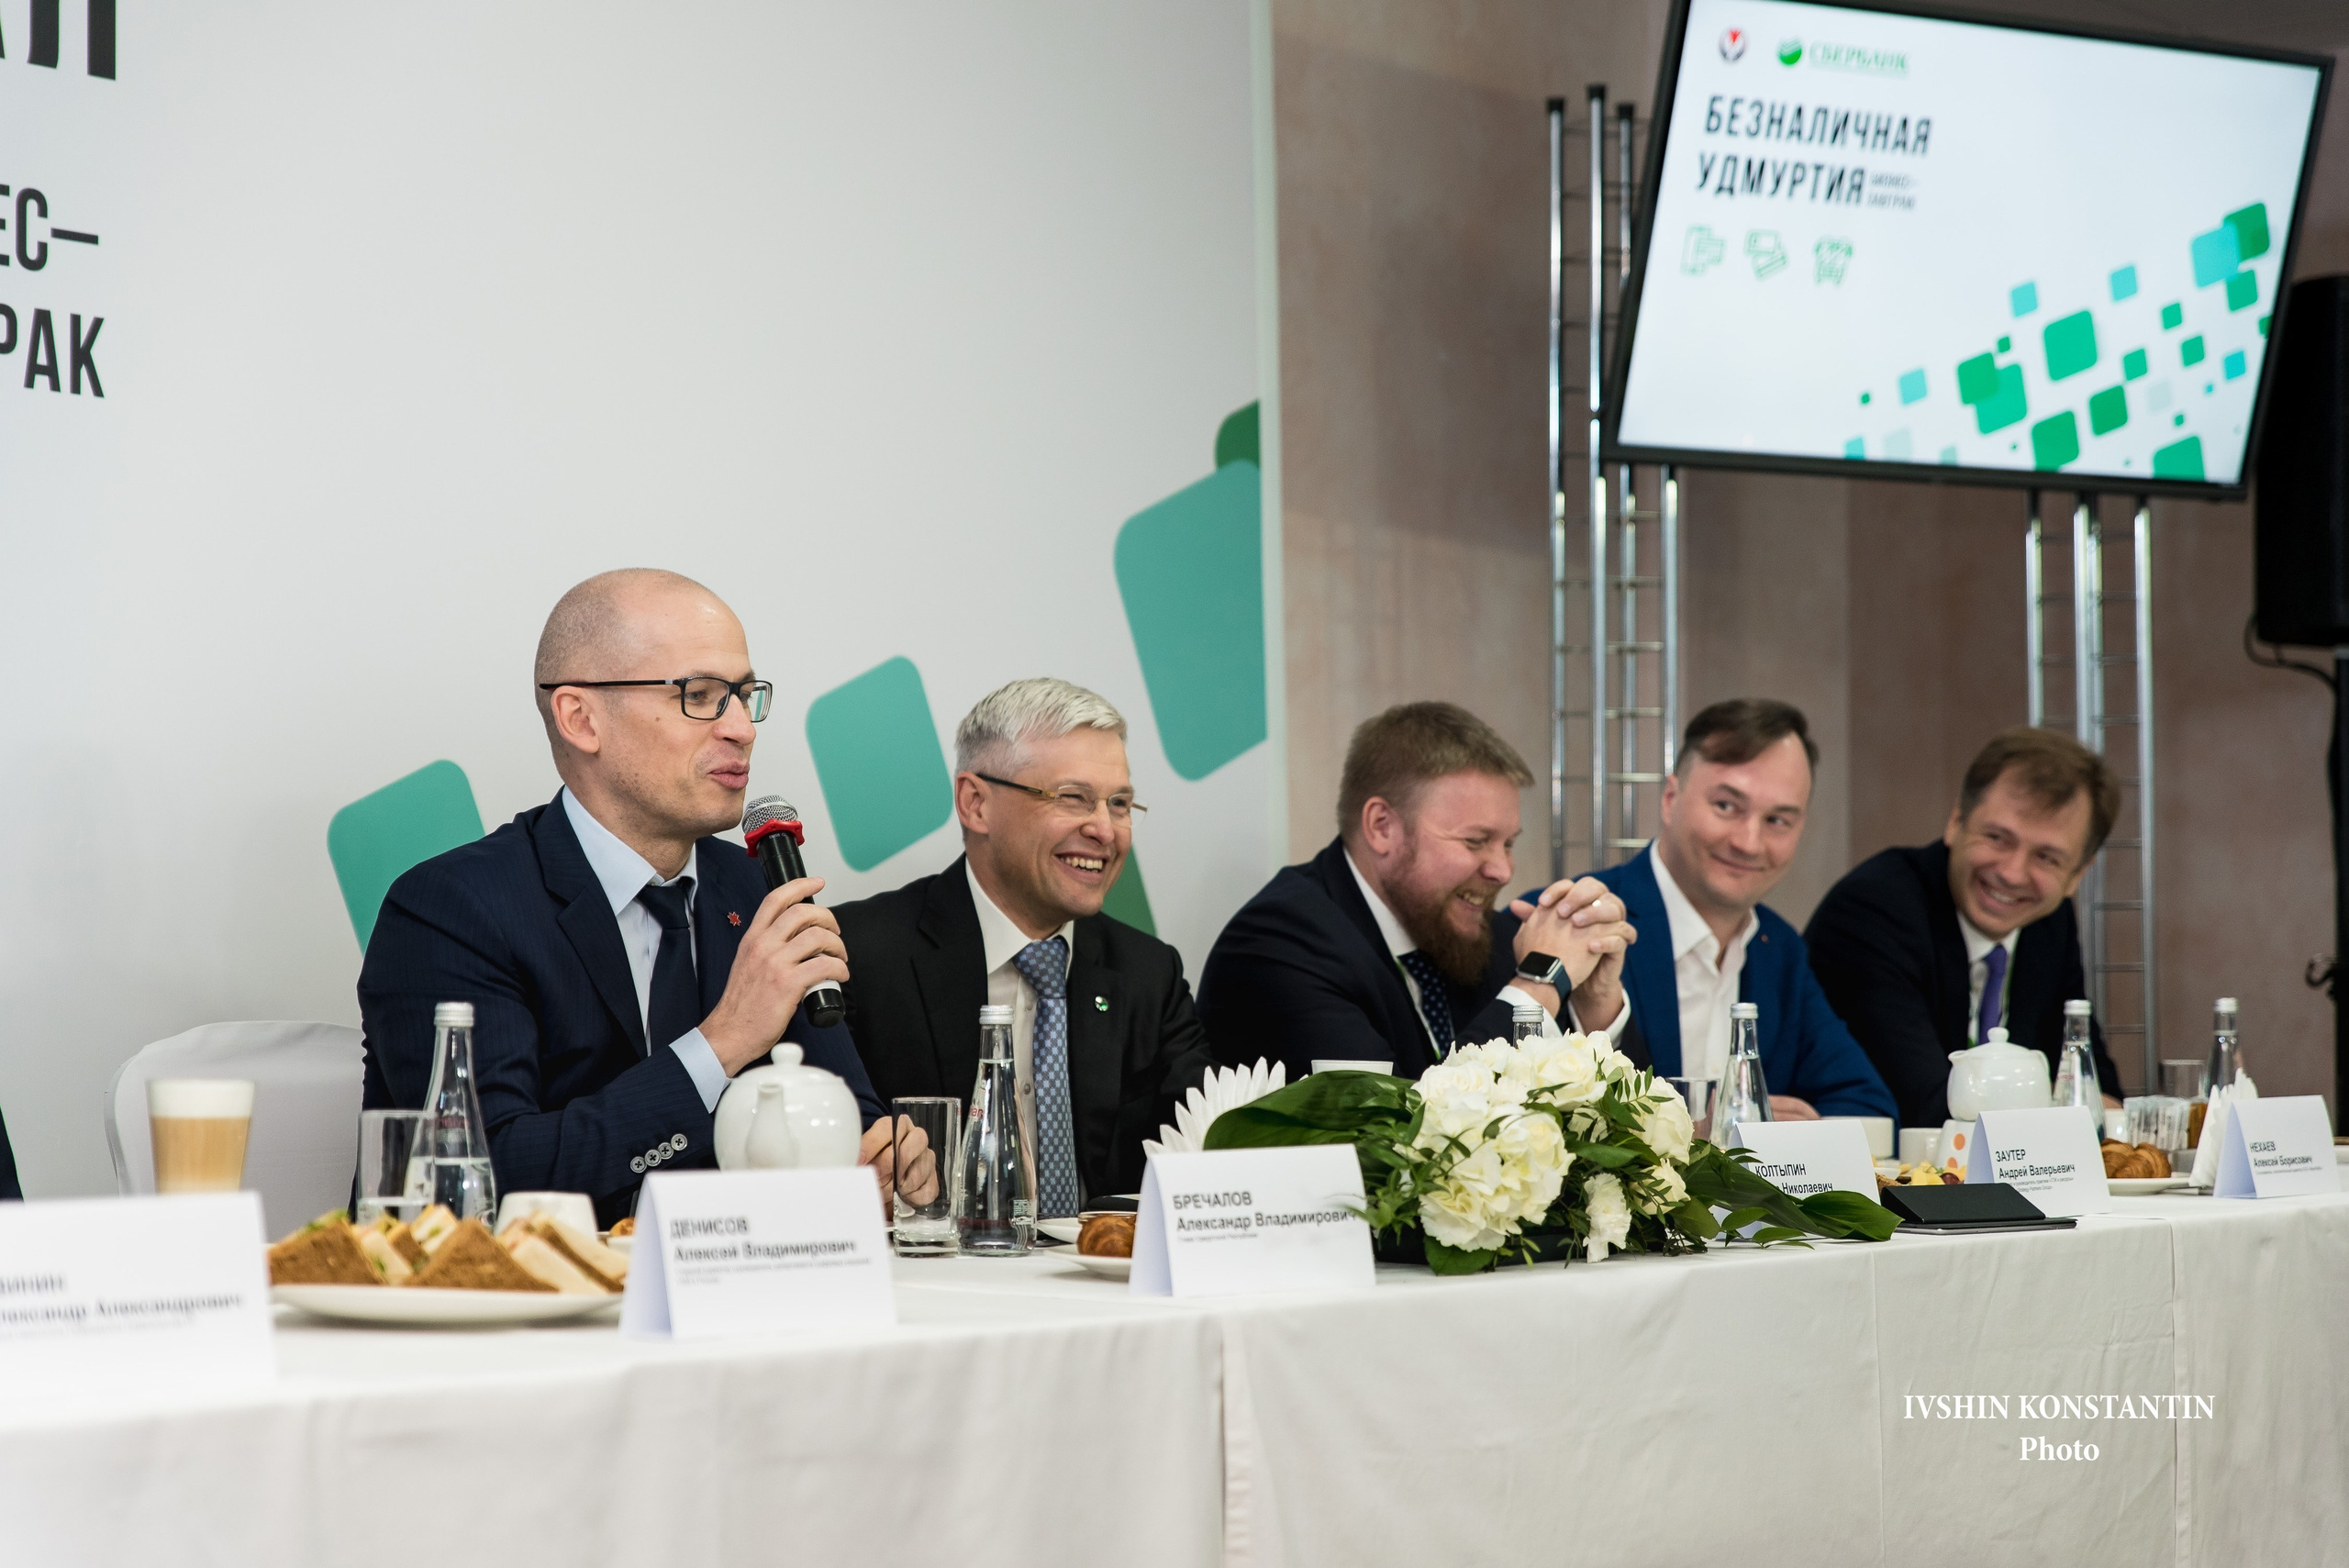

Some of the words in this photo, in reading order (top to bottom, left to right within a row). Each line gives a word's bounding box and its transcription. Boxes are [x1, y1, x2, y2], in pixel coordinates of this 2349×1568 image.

[1705, 95, 1932, 156] БЕЗНАЛИЧНАЯ
[1698, 153, 1865, 204] УДМУРТИЯ
[1995, 1149, 2026, 1162] ЗАУТЕР
[2250, 1141, 2276, 1152] НЕХАЕВ
[1754, 1163, 1807, 1177] КОЛТЫПИН
[1998, 1165, 2028, 1180] Андрей
[2030, 1163, 2076, 1177] Валерьевич
[1781, 1182, 1833, 1194] Николаевич
[1173, 1191, 1252, 1210] БРЕЧАЛОВ
[670, 1218, 749, 1239] ДЕНИСОВ
[1176, 1214, 1252, 1232] Александр
[1254, 1208, 1357, 1228] Владимирович
[674, 1241, 738, 1262] Алексей
[741, 1240, 856, 1261] Владимирович
